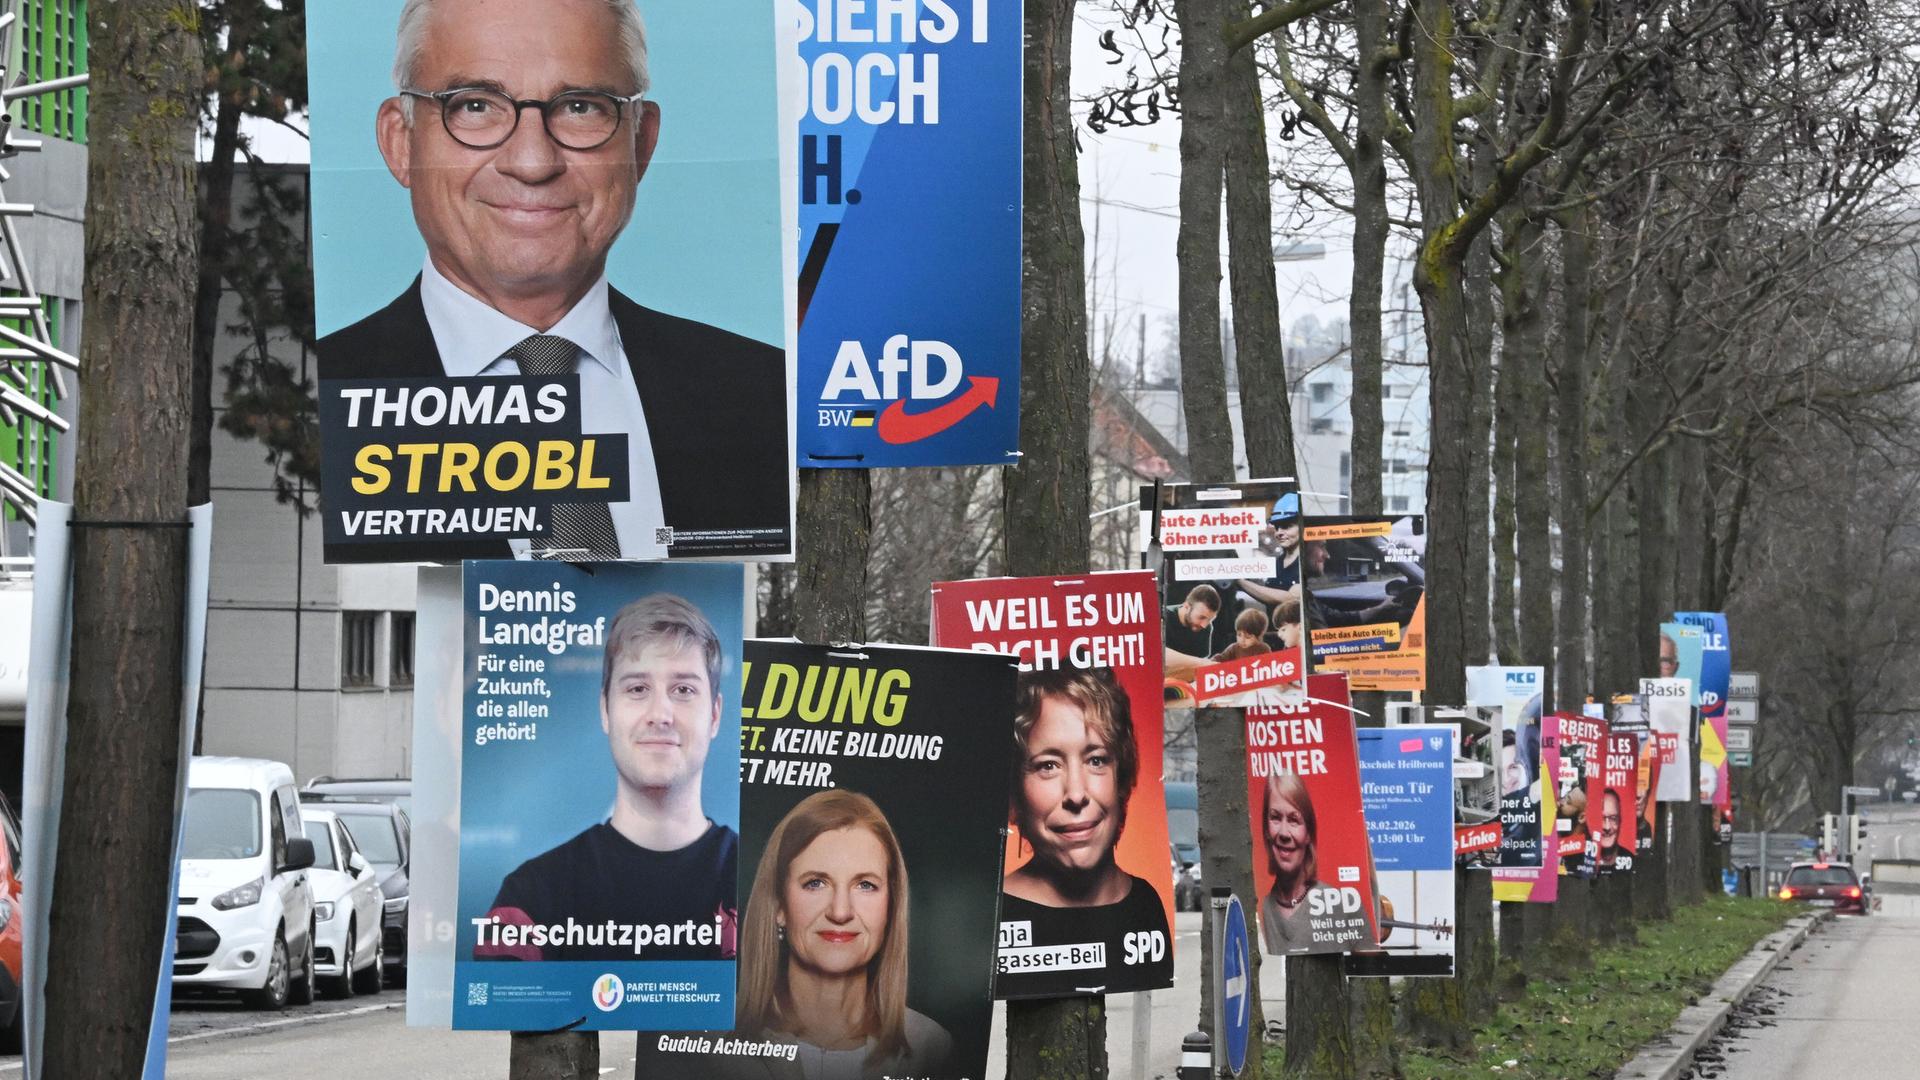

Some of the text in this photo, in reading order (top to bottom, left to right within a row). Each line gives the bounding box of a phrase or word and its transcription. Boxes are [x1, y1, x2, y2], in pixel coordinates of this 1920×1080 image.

[797, 0, 988, 43] IEHST
[797, 52, 939, 124] OCH
[820, 334, 963, 400] AfD
[340, 383, 567, 427] THOMAS
[818, 409, 852, 427] BW
[351, 439, 611, 494] STROBL
[340, 506, 543, 536] VERTRAUEN.
[1200, 511, 1260, 527] Arbeit.
[1161, 530, 1253, 547] öhne rauf.
[1181, 564, 1214, 576] Ohne
[479, 582, 576, 612] Dennis
[965, 592, 1145, 632] WEIL ES UM
[479, 616, 606, 654] Landgraf
[1352, 630, 1370, 638] Auto
[1069, 632, 1145, 669] GEHT!
[1339, 644, 1359, 653] lösen
[477, 655, 545, 672] Für eine
[1204, 660, 1294, 692] Die Linke
[477, 677, 551, 697] Zukunft,
[1645, 682, 1686, 697] Basis
[476, 700, 548, 717] die allen
[475, 722, 537, 745] gehört!
[1248, 718, 1324, 746] KOSTEN
[771, 728, 843, 756] KEINE
[843, 731, 944, 760] BILDUNG
[1618, 738, 1631, 753] ES
[1251, 749, 1328, 777] RUNTER
[1398, 760, 1445, 769] Heilbronn
[1606, 754, 1634, 770] DICH
[763, 760, 836, 788] MEHR.
[1408, 782, 1434, 794] Tür
[1523, 796, 1531, 808] &
[1501, 811, 1536, 823] chmid
[1378, 834, 1403, 843] 13:00
[1406, 833, 1426, 843] Uhr
[1460, 830, 1496, 849] Linke
[1308, 887, 1361, 916] SPD
[1311, 917, 1364, 930] Weil es um
[471, 914, 722, 955] Tierschutzpartei
[1313, 929, 1363, 944] Dich geht.
[1123, 930, 1165, 966] SPD
[626, 982, 697, 992] PARTEI MENSCH
[626, 993, 721, 1003] UMWELT TIERSCHUTZ
[657, 1034, 798, 1062] Gudula Achterberg
